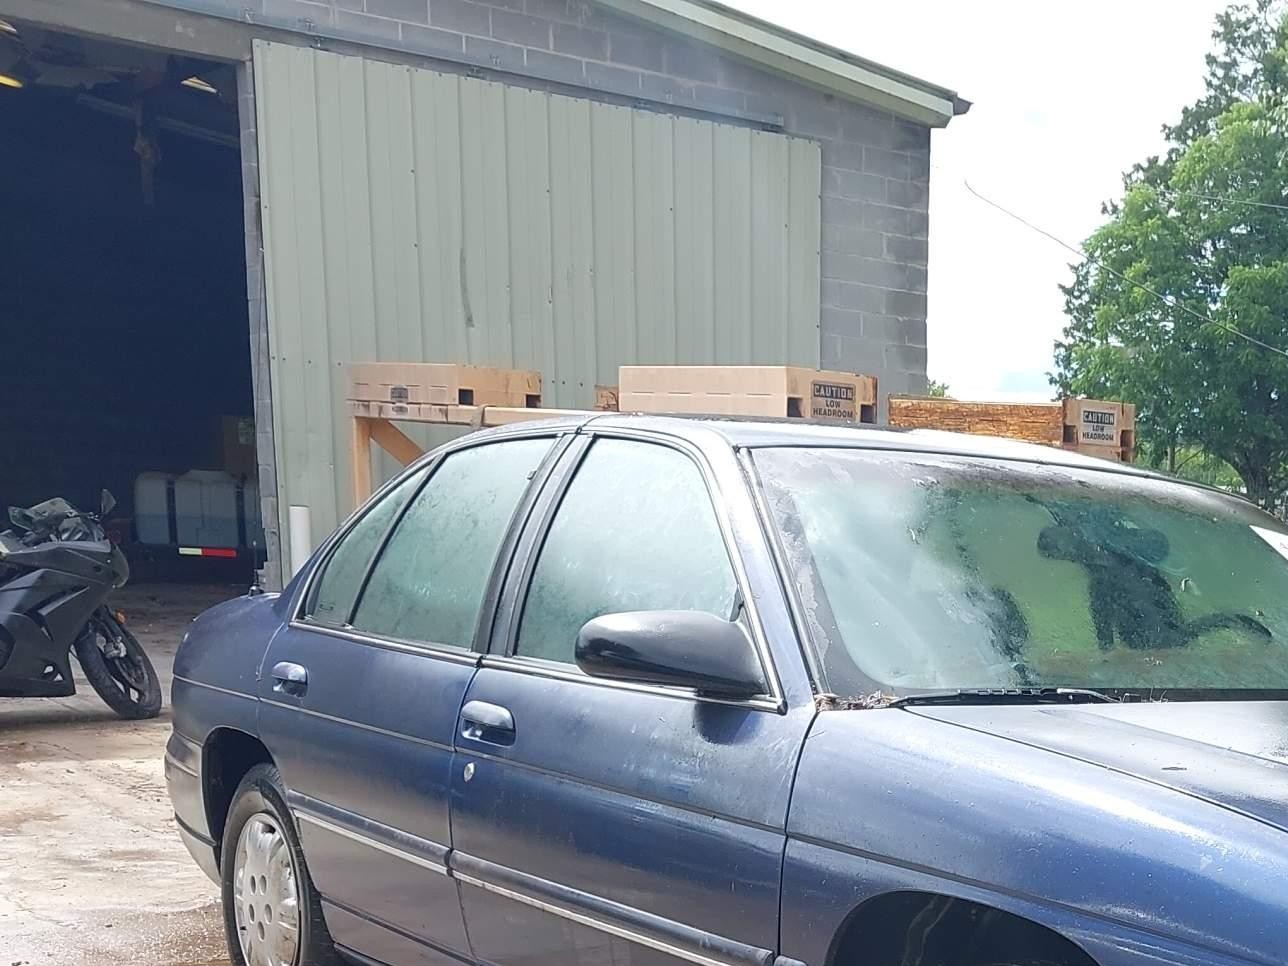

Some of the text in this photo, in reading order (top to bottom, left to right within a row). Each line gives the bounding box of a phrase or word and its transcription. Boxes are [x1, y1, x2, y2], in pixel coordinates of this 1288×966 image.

[814, 385, 853, 399] CAUTION
[825, 400, 841, 408] LOW
[812, 408, 853, 418] HEADROOM
[1083, 411, 1115, 424] CAUTION
[1092, 424, 1105, 432] LOW
[1082, 432, 1114, 441] HEADROOM
